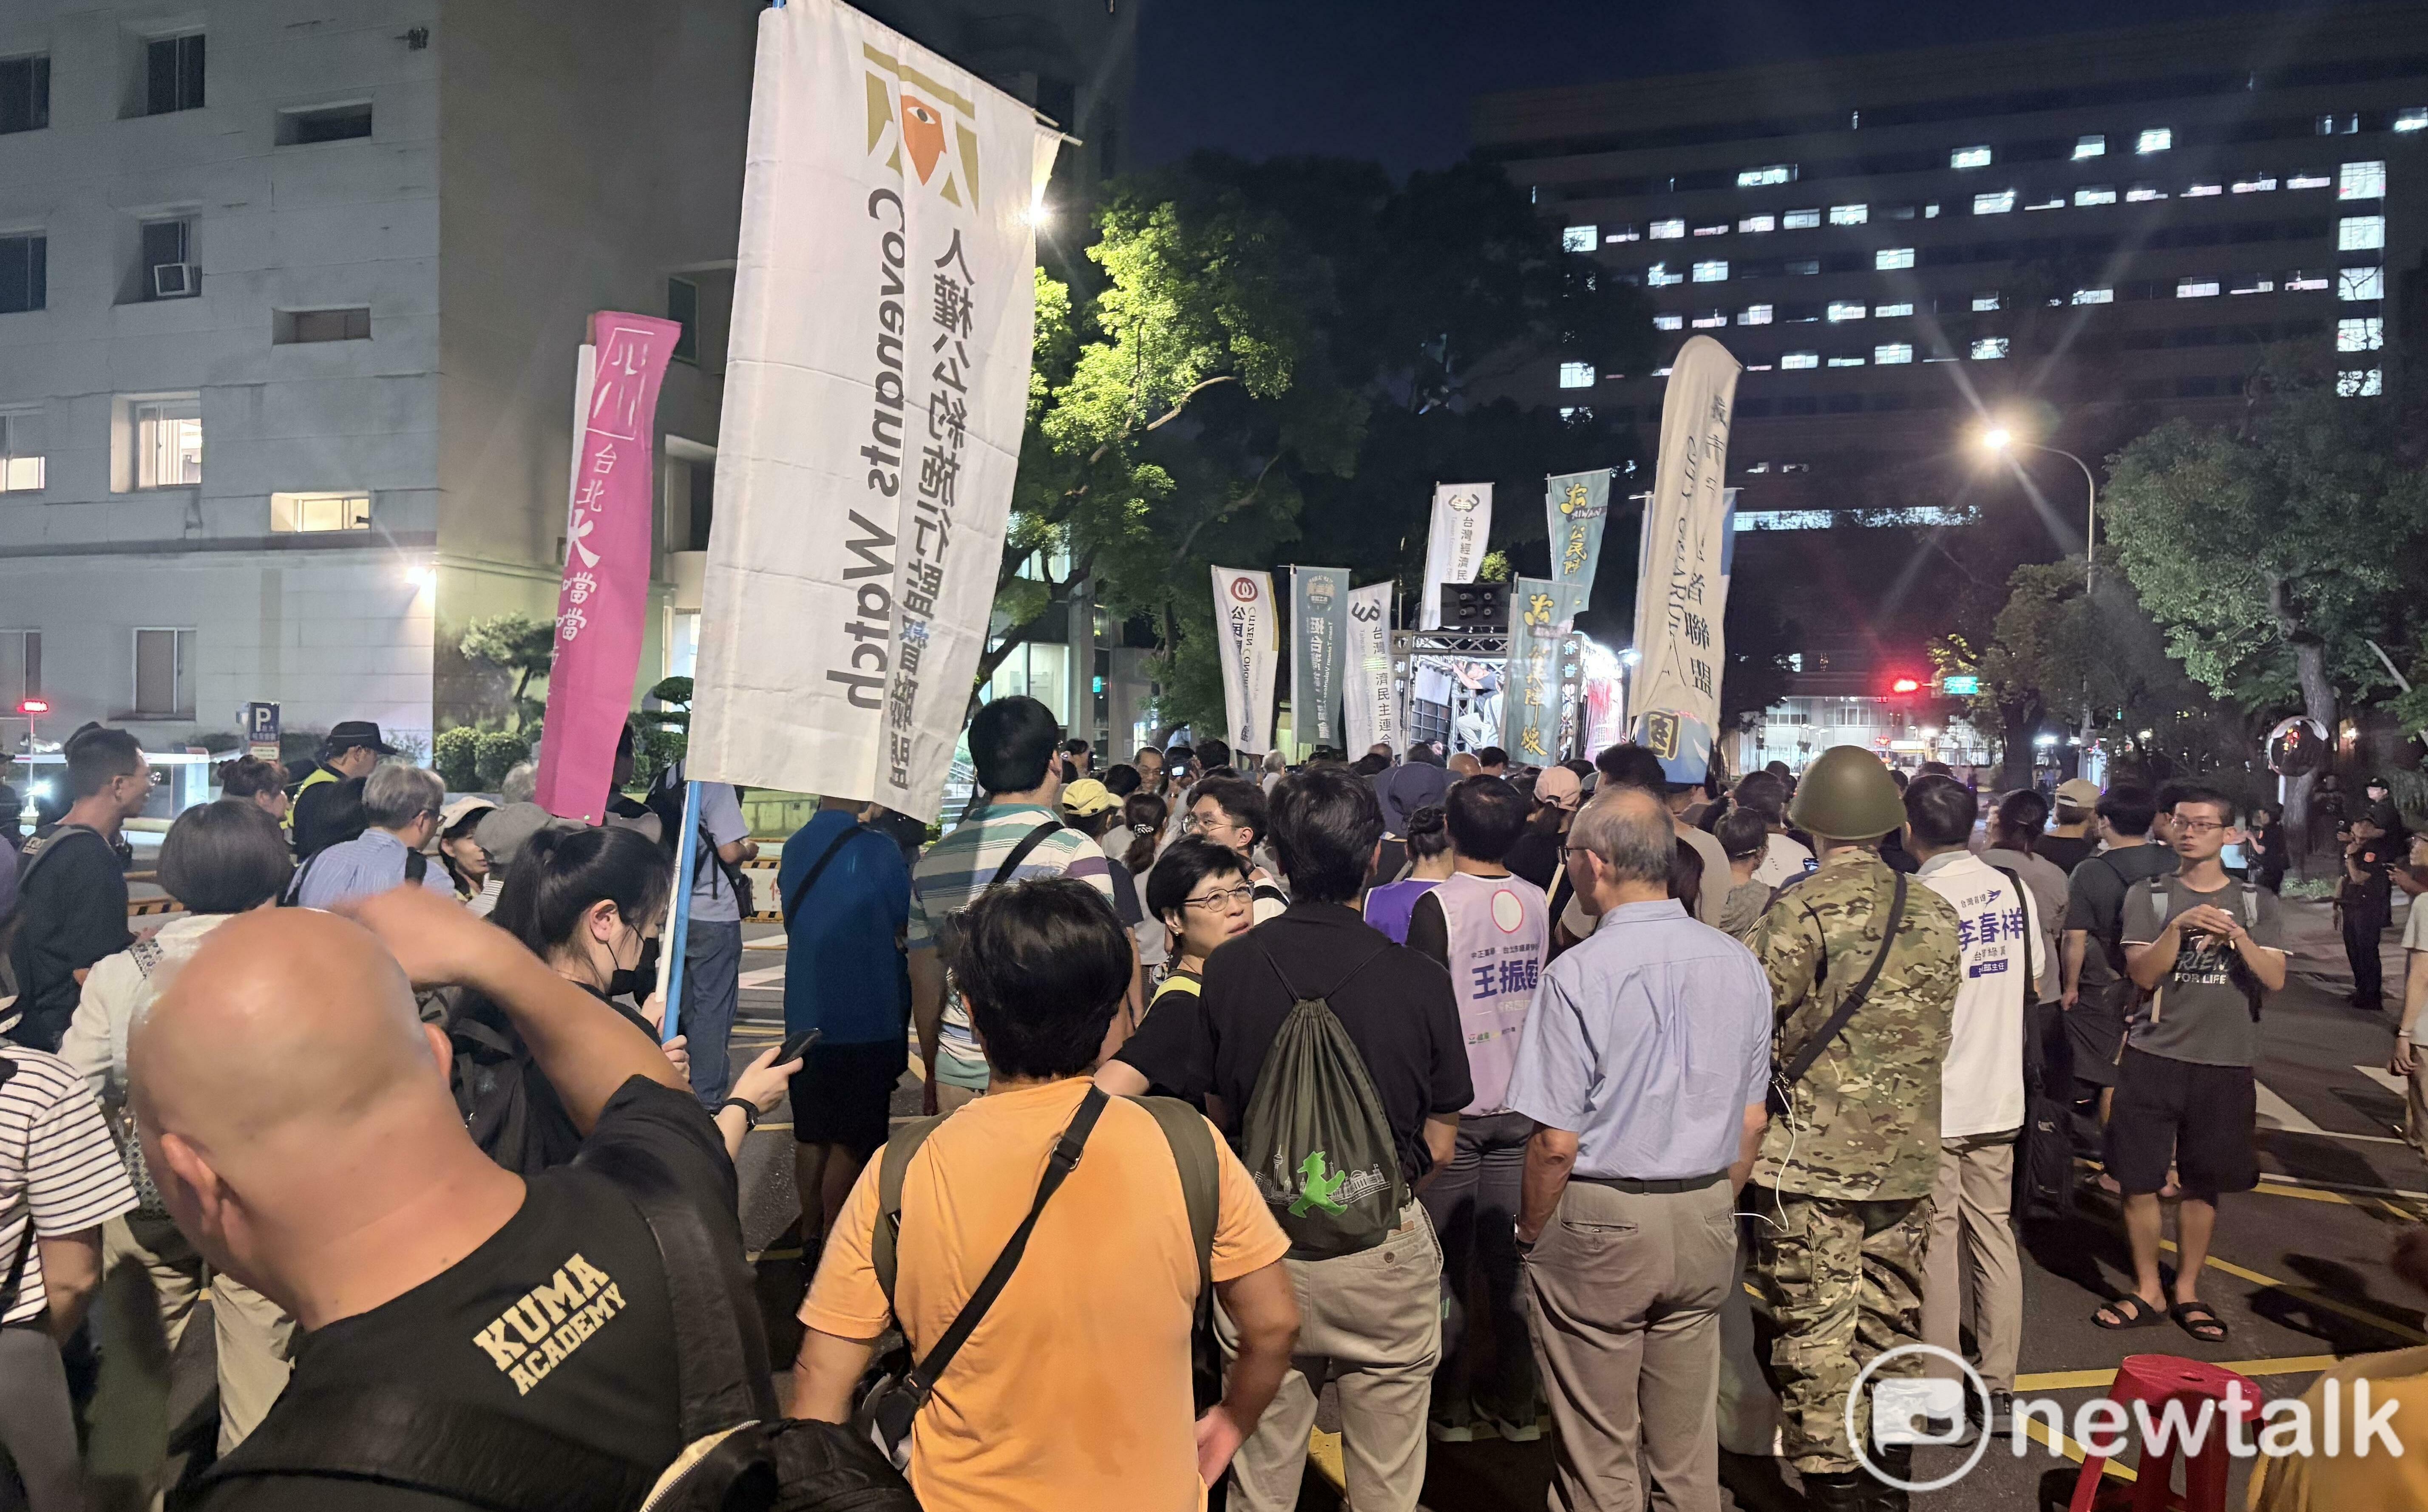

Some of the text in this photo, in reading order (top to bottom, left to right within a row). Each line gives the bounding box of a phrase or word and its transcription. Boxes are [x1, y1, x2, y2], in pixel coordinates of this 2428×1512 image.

[256, 708, 271, 732] P
[1958, 907, 2024, 952] 李春祥
[2175, 972, 2227, 984] FOR LIFE
[472, 1252, 610, 1372] KUMA
[508, 1282, 627, 1397] ACADEMY
